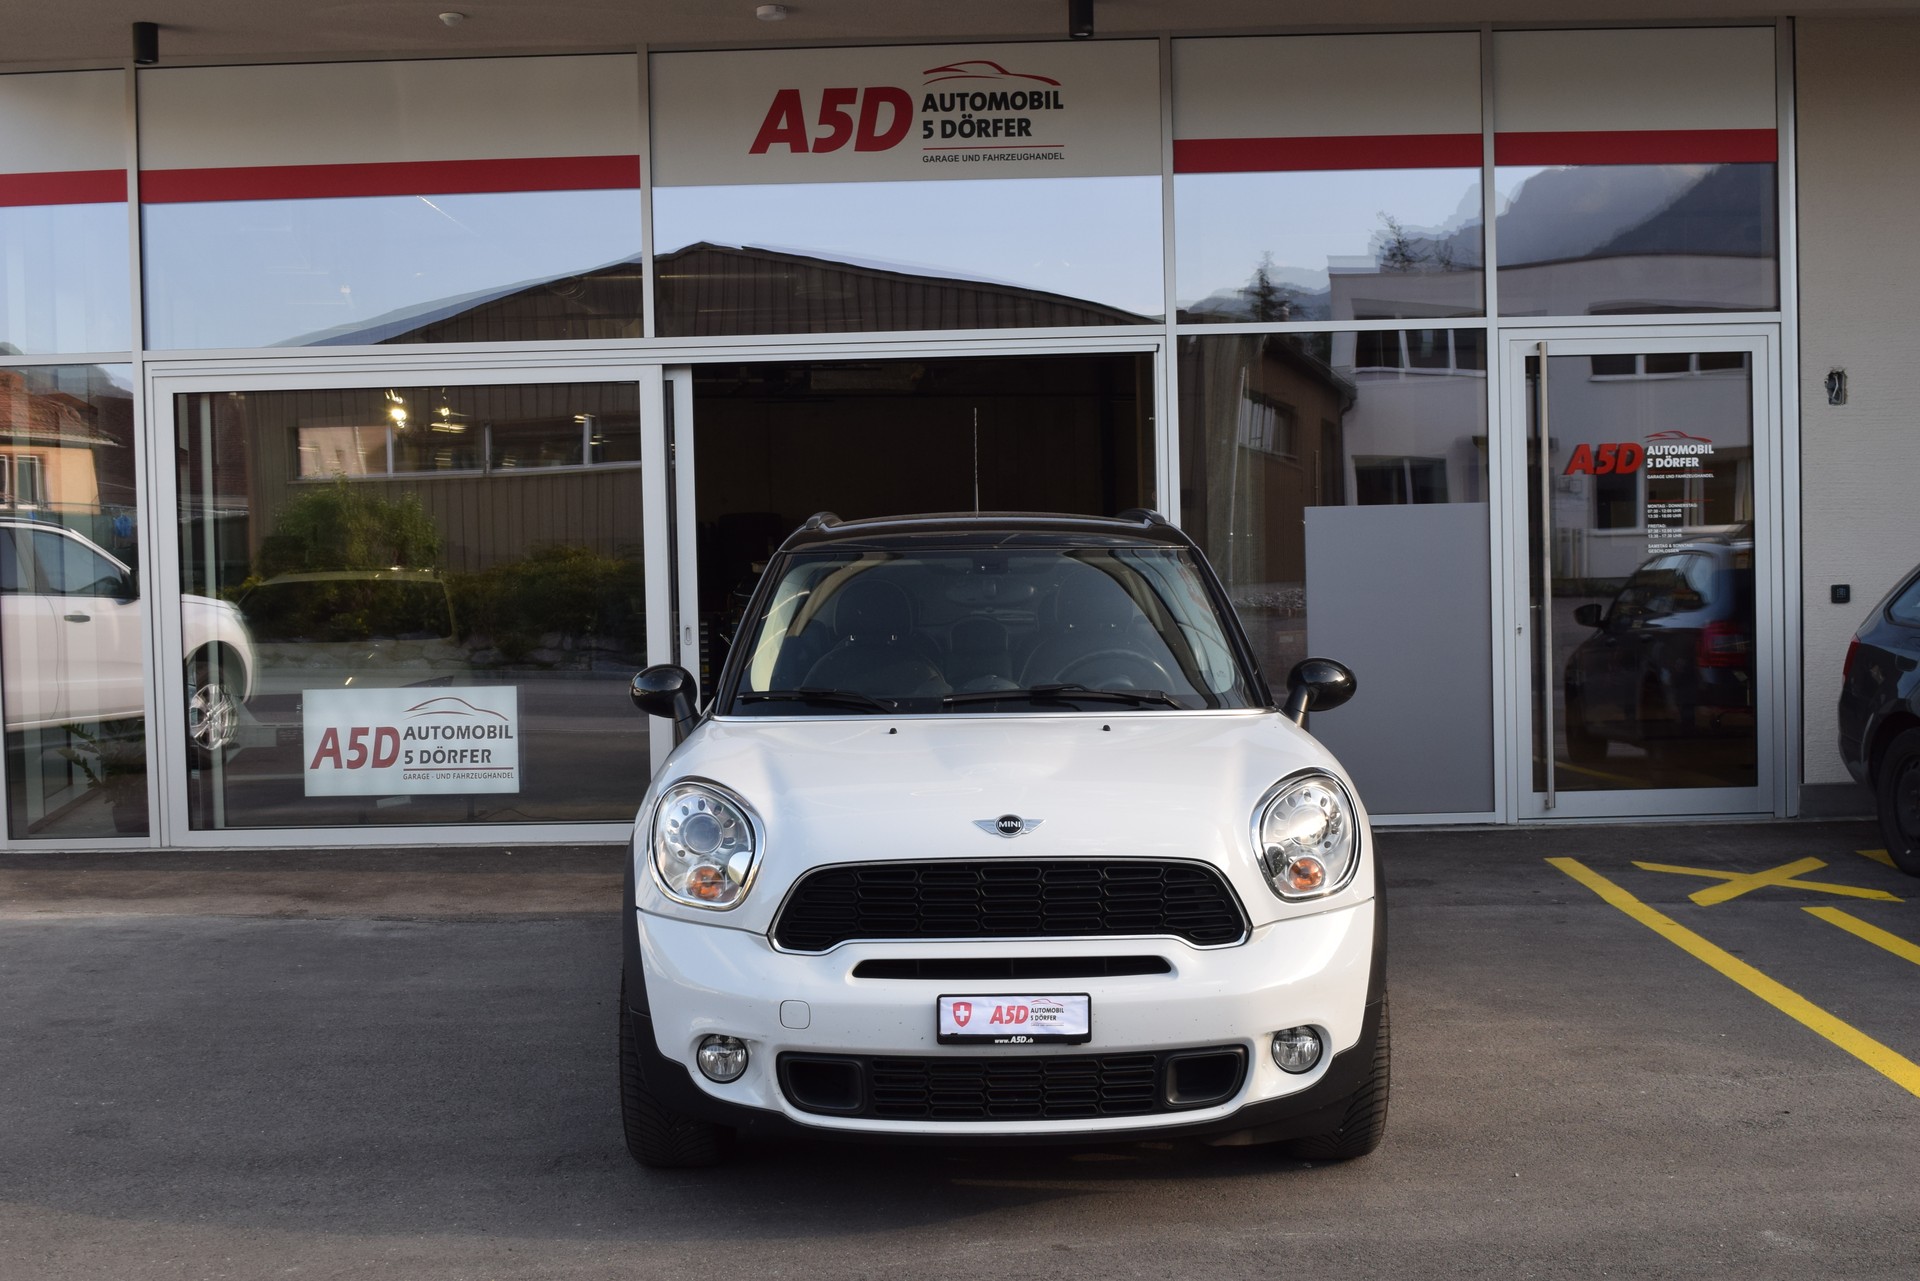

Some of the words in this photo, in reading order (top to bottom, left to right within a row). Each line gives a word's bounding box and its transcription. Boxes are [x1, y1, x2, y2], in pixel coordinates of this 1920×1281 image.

[921, 90, 1064, 113] AUTOMOBIL
[748, 86, 914, 155] A5D
[922, 120, 934, 139] 5
[940, 113, 1032, 139] DÖRFER
[922, 154, 960, 163] GARAGE
[961, 153, 981, 162] UND
[982, 152, 1065, 162] FAHRZEUGHANDEL
[1564, 442, 1645, 475] A5D
[1647, 444, 1714, 456] AUTOMOBIL
[1647, 458, 1654, 468] 5
[1655, 455, 1699, 468] DÖRFER
[403, 724, 514, 741] AUTOMOBIL
[309, 726, 400, 769] A5D
[404, 750, 413, 764] 5
[419, 746, 492, 764] DÖRFER
[452, 772, 514, 780] FAHRZEUGHANDEL
[998, 820, 1021, 828] MINI
[989, 1005, 1029, 1025] A5D
[1035, 1013, 1057, 1021] DÖRFER
[994, 1035, 1034, 1044] www.A5D.ch
